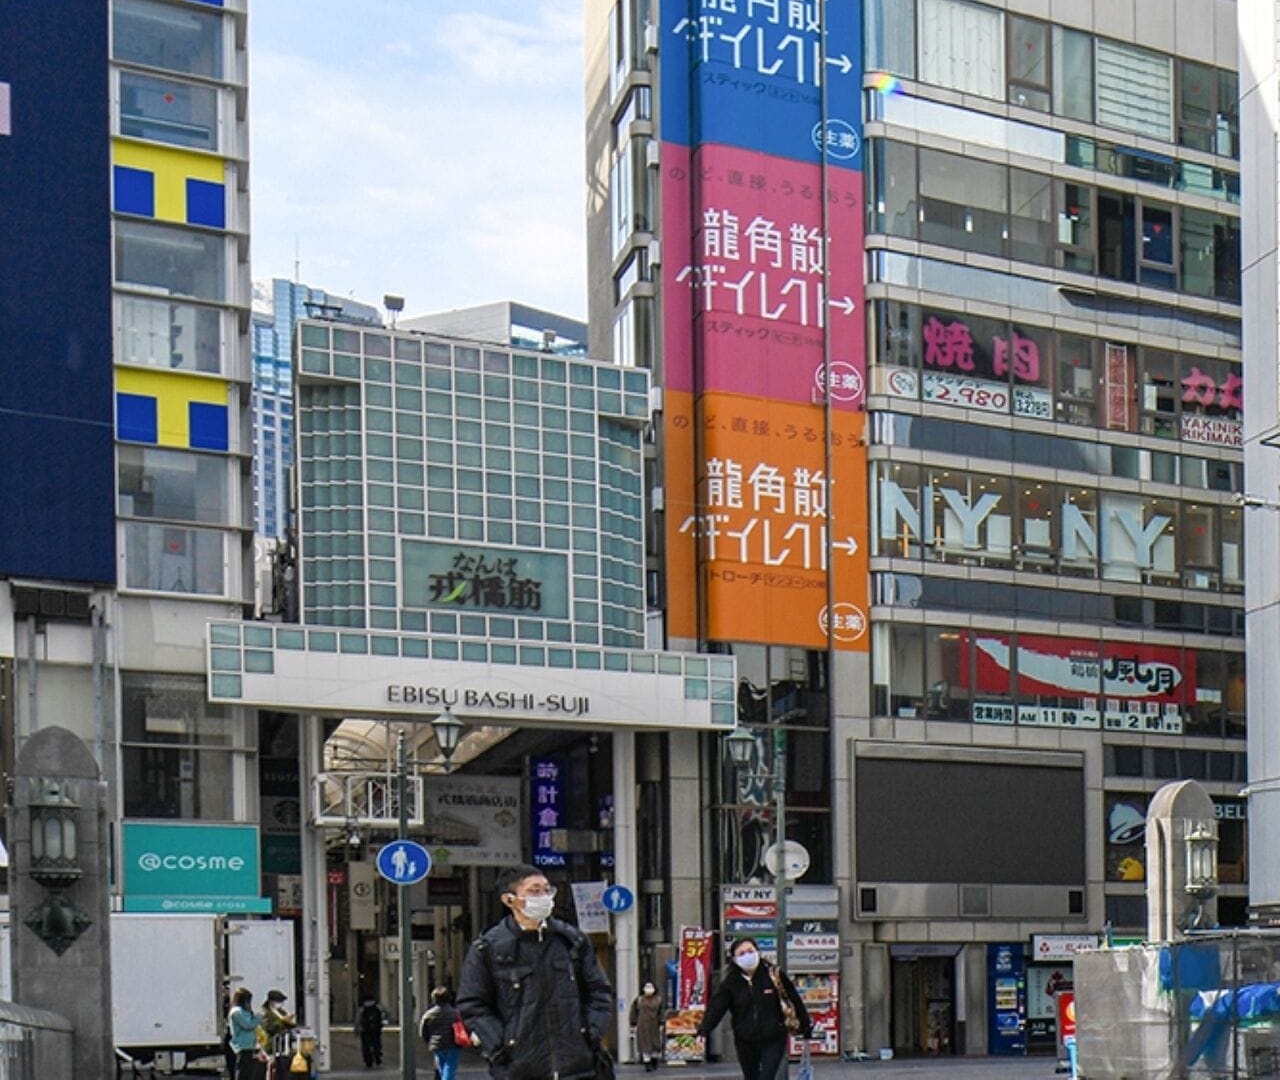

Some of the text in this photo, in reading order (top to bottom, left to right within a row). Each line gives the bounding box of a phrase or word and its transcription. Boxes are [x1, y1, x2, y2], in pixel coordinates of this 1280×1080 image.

[672, 15, 853, 88] ダイレクト
[702, 207, 832, 275] 龍角散
[675, 264, 855, 328] ダイレクト
[922, 315, 1041, 383] 焼肉
[1182, 415, 1242, 434] YAKINIK
[1182, 428, 1243, 446] RIKIMAR
[705, 457, 835, 520] 龍角散
[679, 514, 858, 570] ダイレクト
[452, 551, 519, 578] なんば
[386, 684, 459, 707] EBISU
[1103, 654, 1175, 697] 風月
[138, 852, 245, 872] @cosme
[732, 889, 772, 899] NY NY
